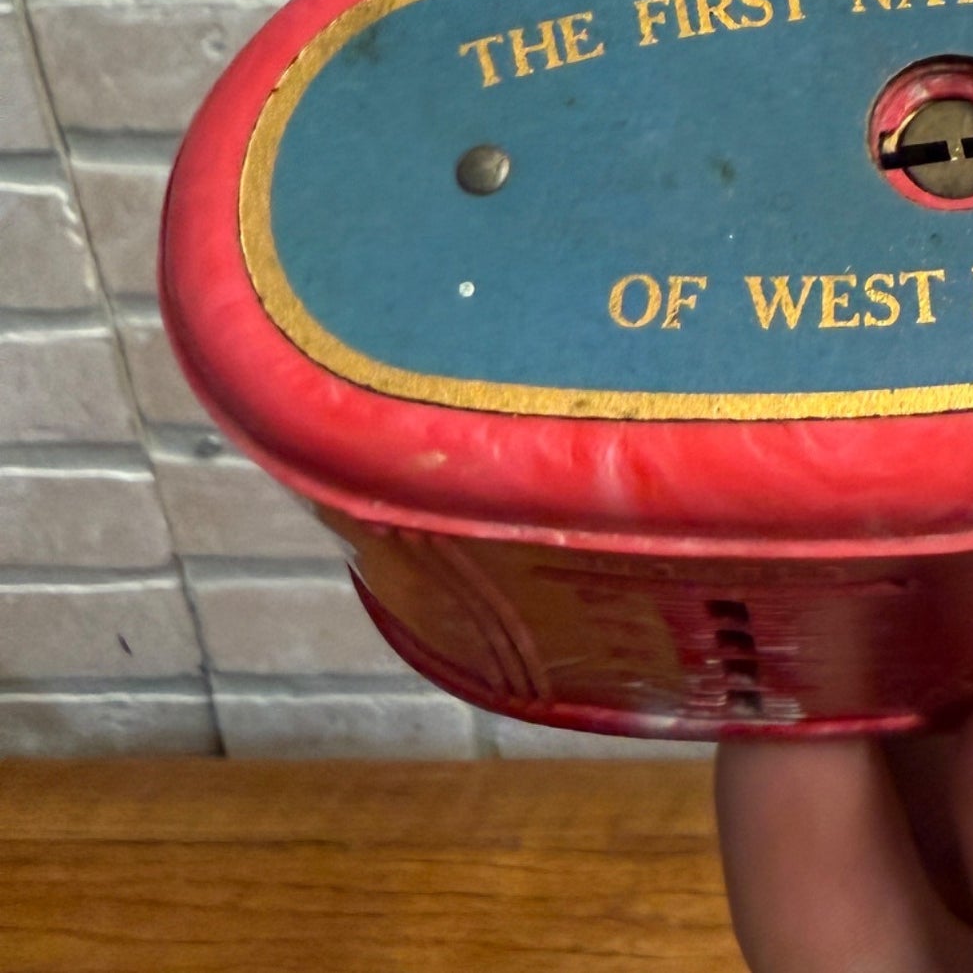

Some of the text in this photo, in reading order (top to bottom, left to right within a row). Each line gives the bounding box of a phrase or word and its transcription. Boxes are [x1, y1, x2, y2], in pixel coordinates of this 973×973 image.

[459, 12, 604, 87] THE
[608, 274, 707, 330] OF
[745, 270, 946, 330] WEST
